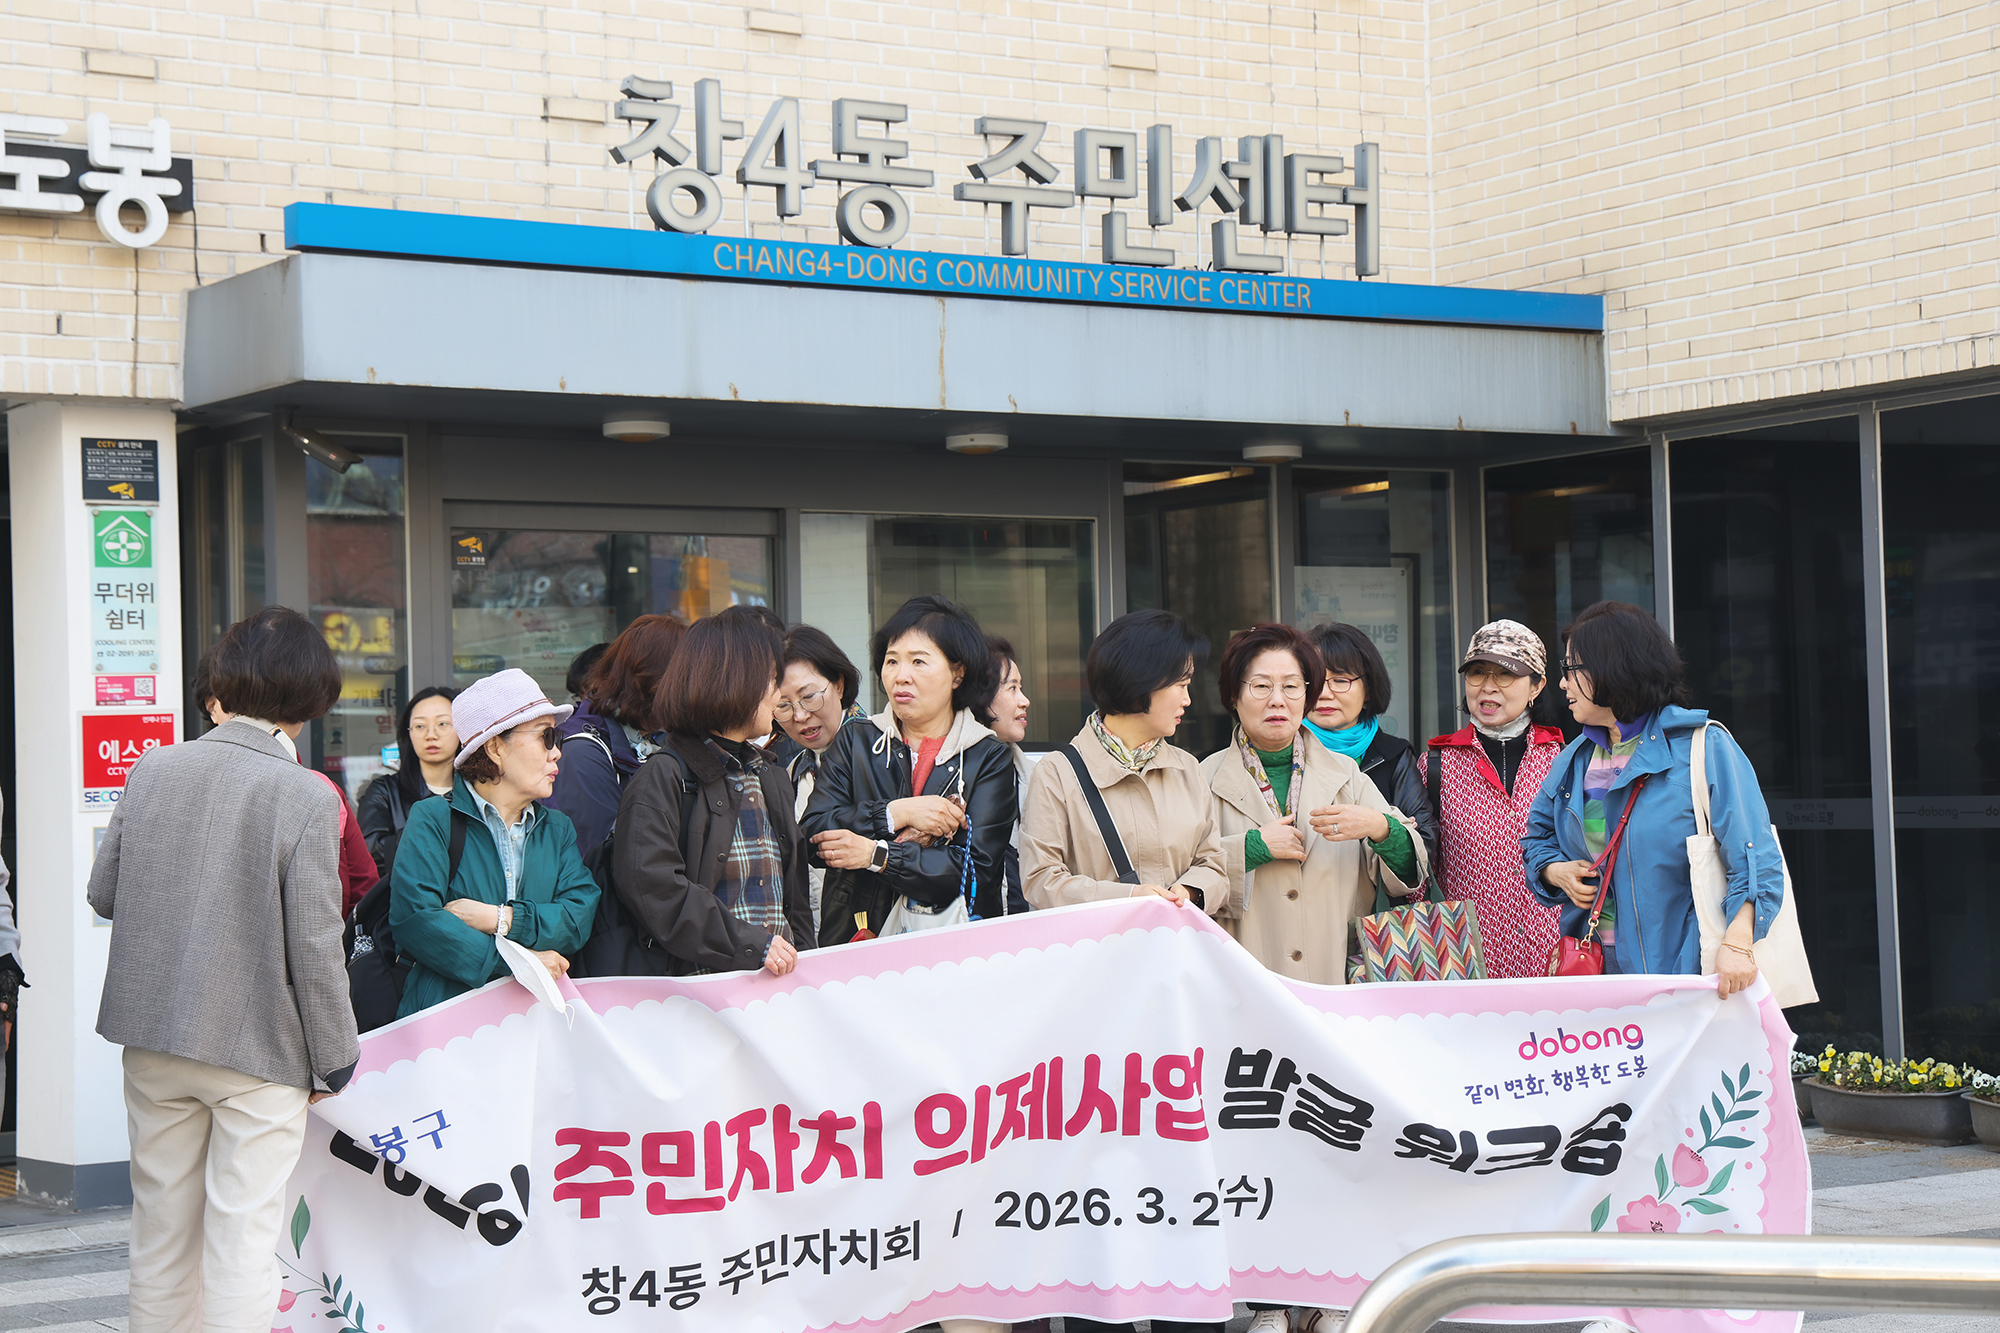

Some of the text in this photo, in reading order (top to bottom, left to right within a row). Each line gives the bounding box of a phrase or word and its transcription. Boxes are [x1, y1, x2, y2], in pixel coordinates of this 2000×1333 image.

[608, 74, 1380, 277] 창4동 주민센터
[714, 242, 1312, 310] CHANG4-DONG COMMUNITY SERVICE CENTER
[96, 440, 117, 448] CCTV
[94, 582, 154, 604] 무더위
[105, 609, 145, 630] 쉼터
[84, 790, 123, 803] SECO
[1917, 805, 1959, 819] dobong
[1518, 1023, 1644, 1061] dobong
[1463, 1055, 1649, 1105] 같이 변화, 행복한 도봉
[552, 1101, 884, 1220] 주민자치
[913, 1046, 1210, 1177] 의제사업
[1218, 1046, 1375, 1152] 발굴
[581, 1262, 707, 1316] 창4동
[718, 1219, 921, 1297] 주민자치회
[994, 1187, 1123, 1231] 2026.
[1136, 1187, 1178, 1226] 3.
